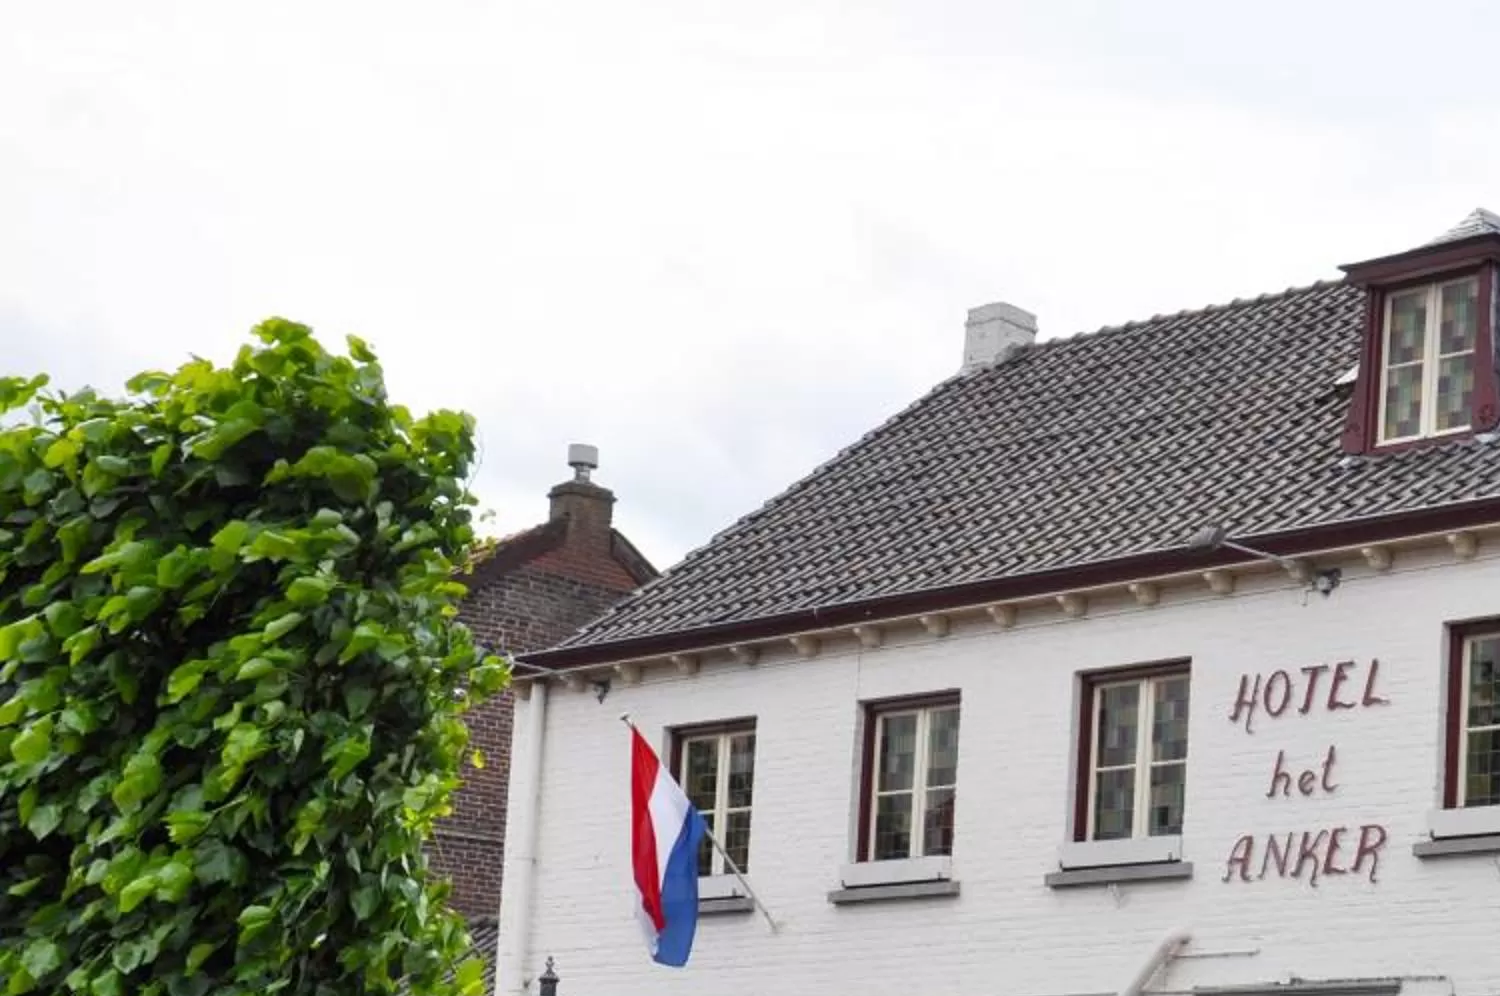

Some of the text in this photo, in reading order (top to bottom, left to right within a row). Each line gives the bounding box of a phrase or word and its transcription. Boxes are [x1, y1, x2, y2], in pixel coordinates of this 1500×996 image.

[1228, 658, 1391, 735] HOTEL
[1266, 745, 1339, 798] het
[1221, 823, 1387, 888] ANKER
